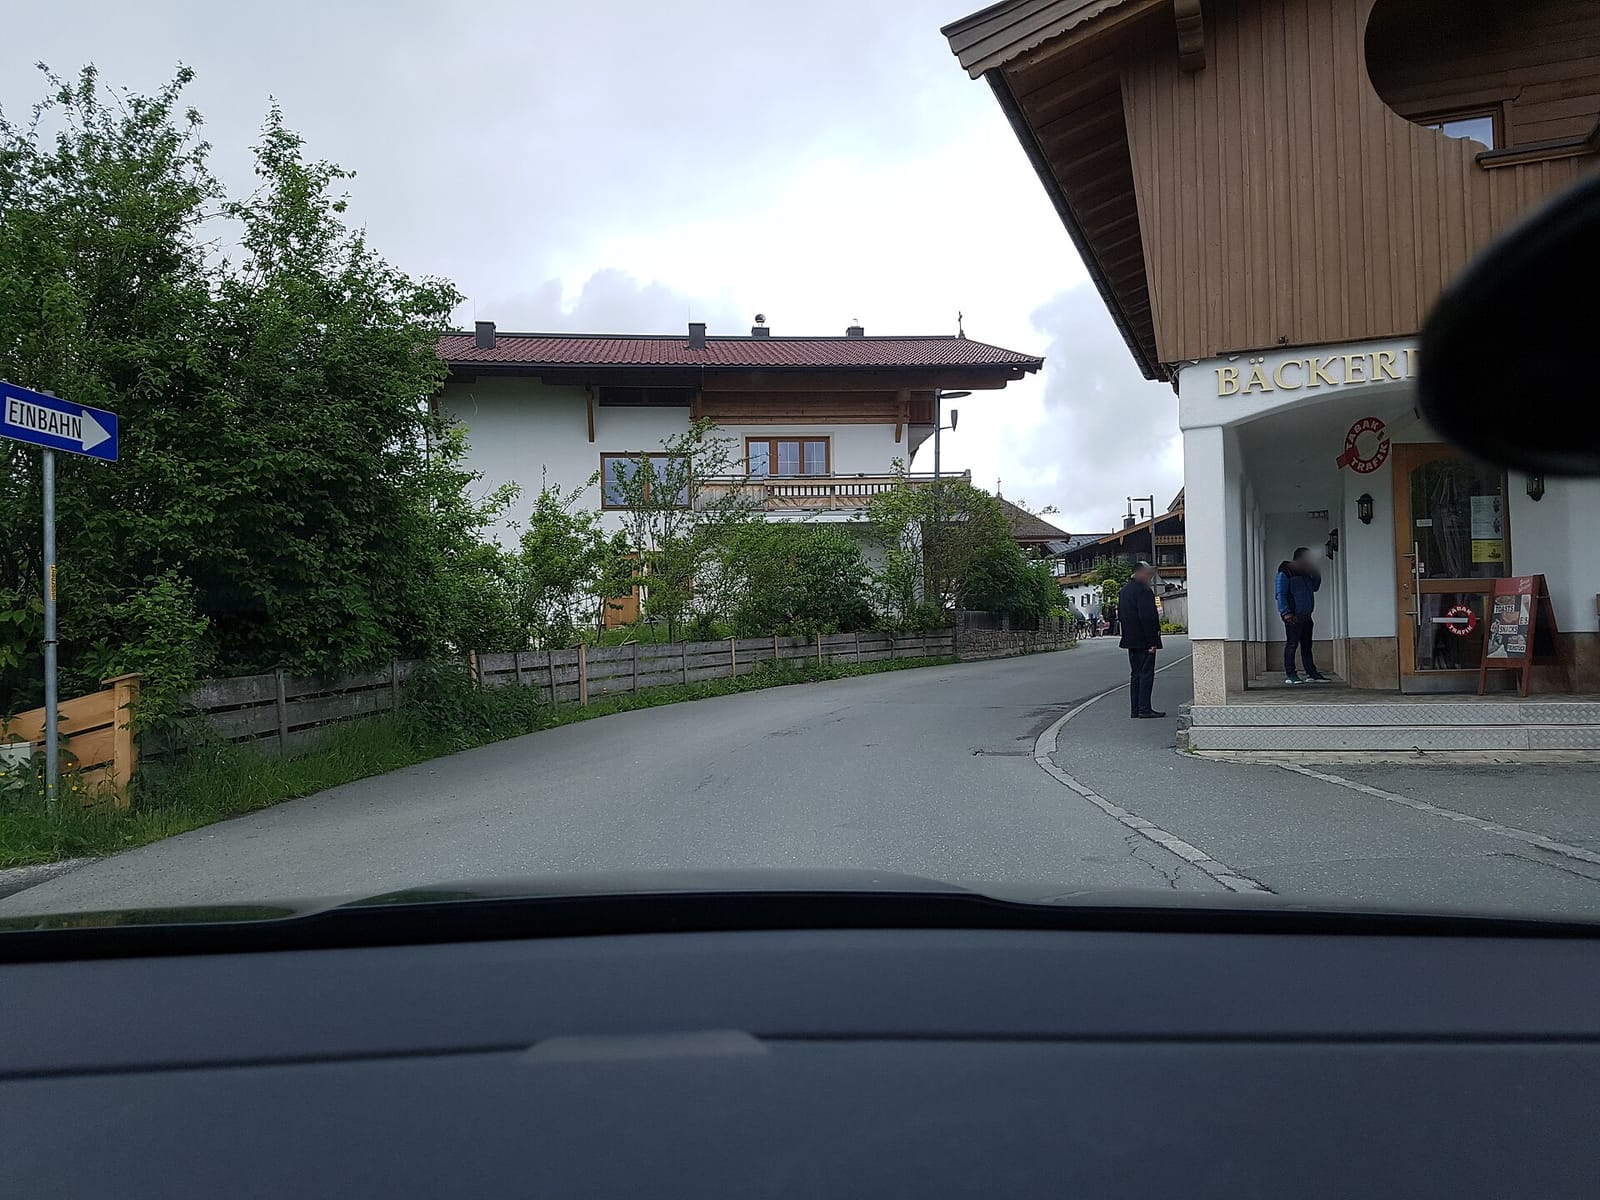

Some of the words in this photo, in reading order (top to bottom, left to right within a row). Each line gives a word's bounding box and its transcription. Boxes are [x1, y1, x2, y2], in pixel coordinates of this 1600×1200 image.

[9, 400, 82, 439] EINBAHN
[1447, 606, 1472, 617] TABAK
[1448, 624, 1473, 635] TRAFIK
